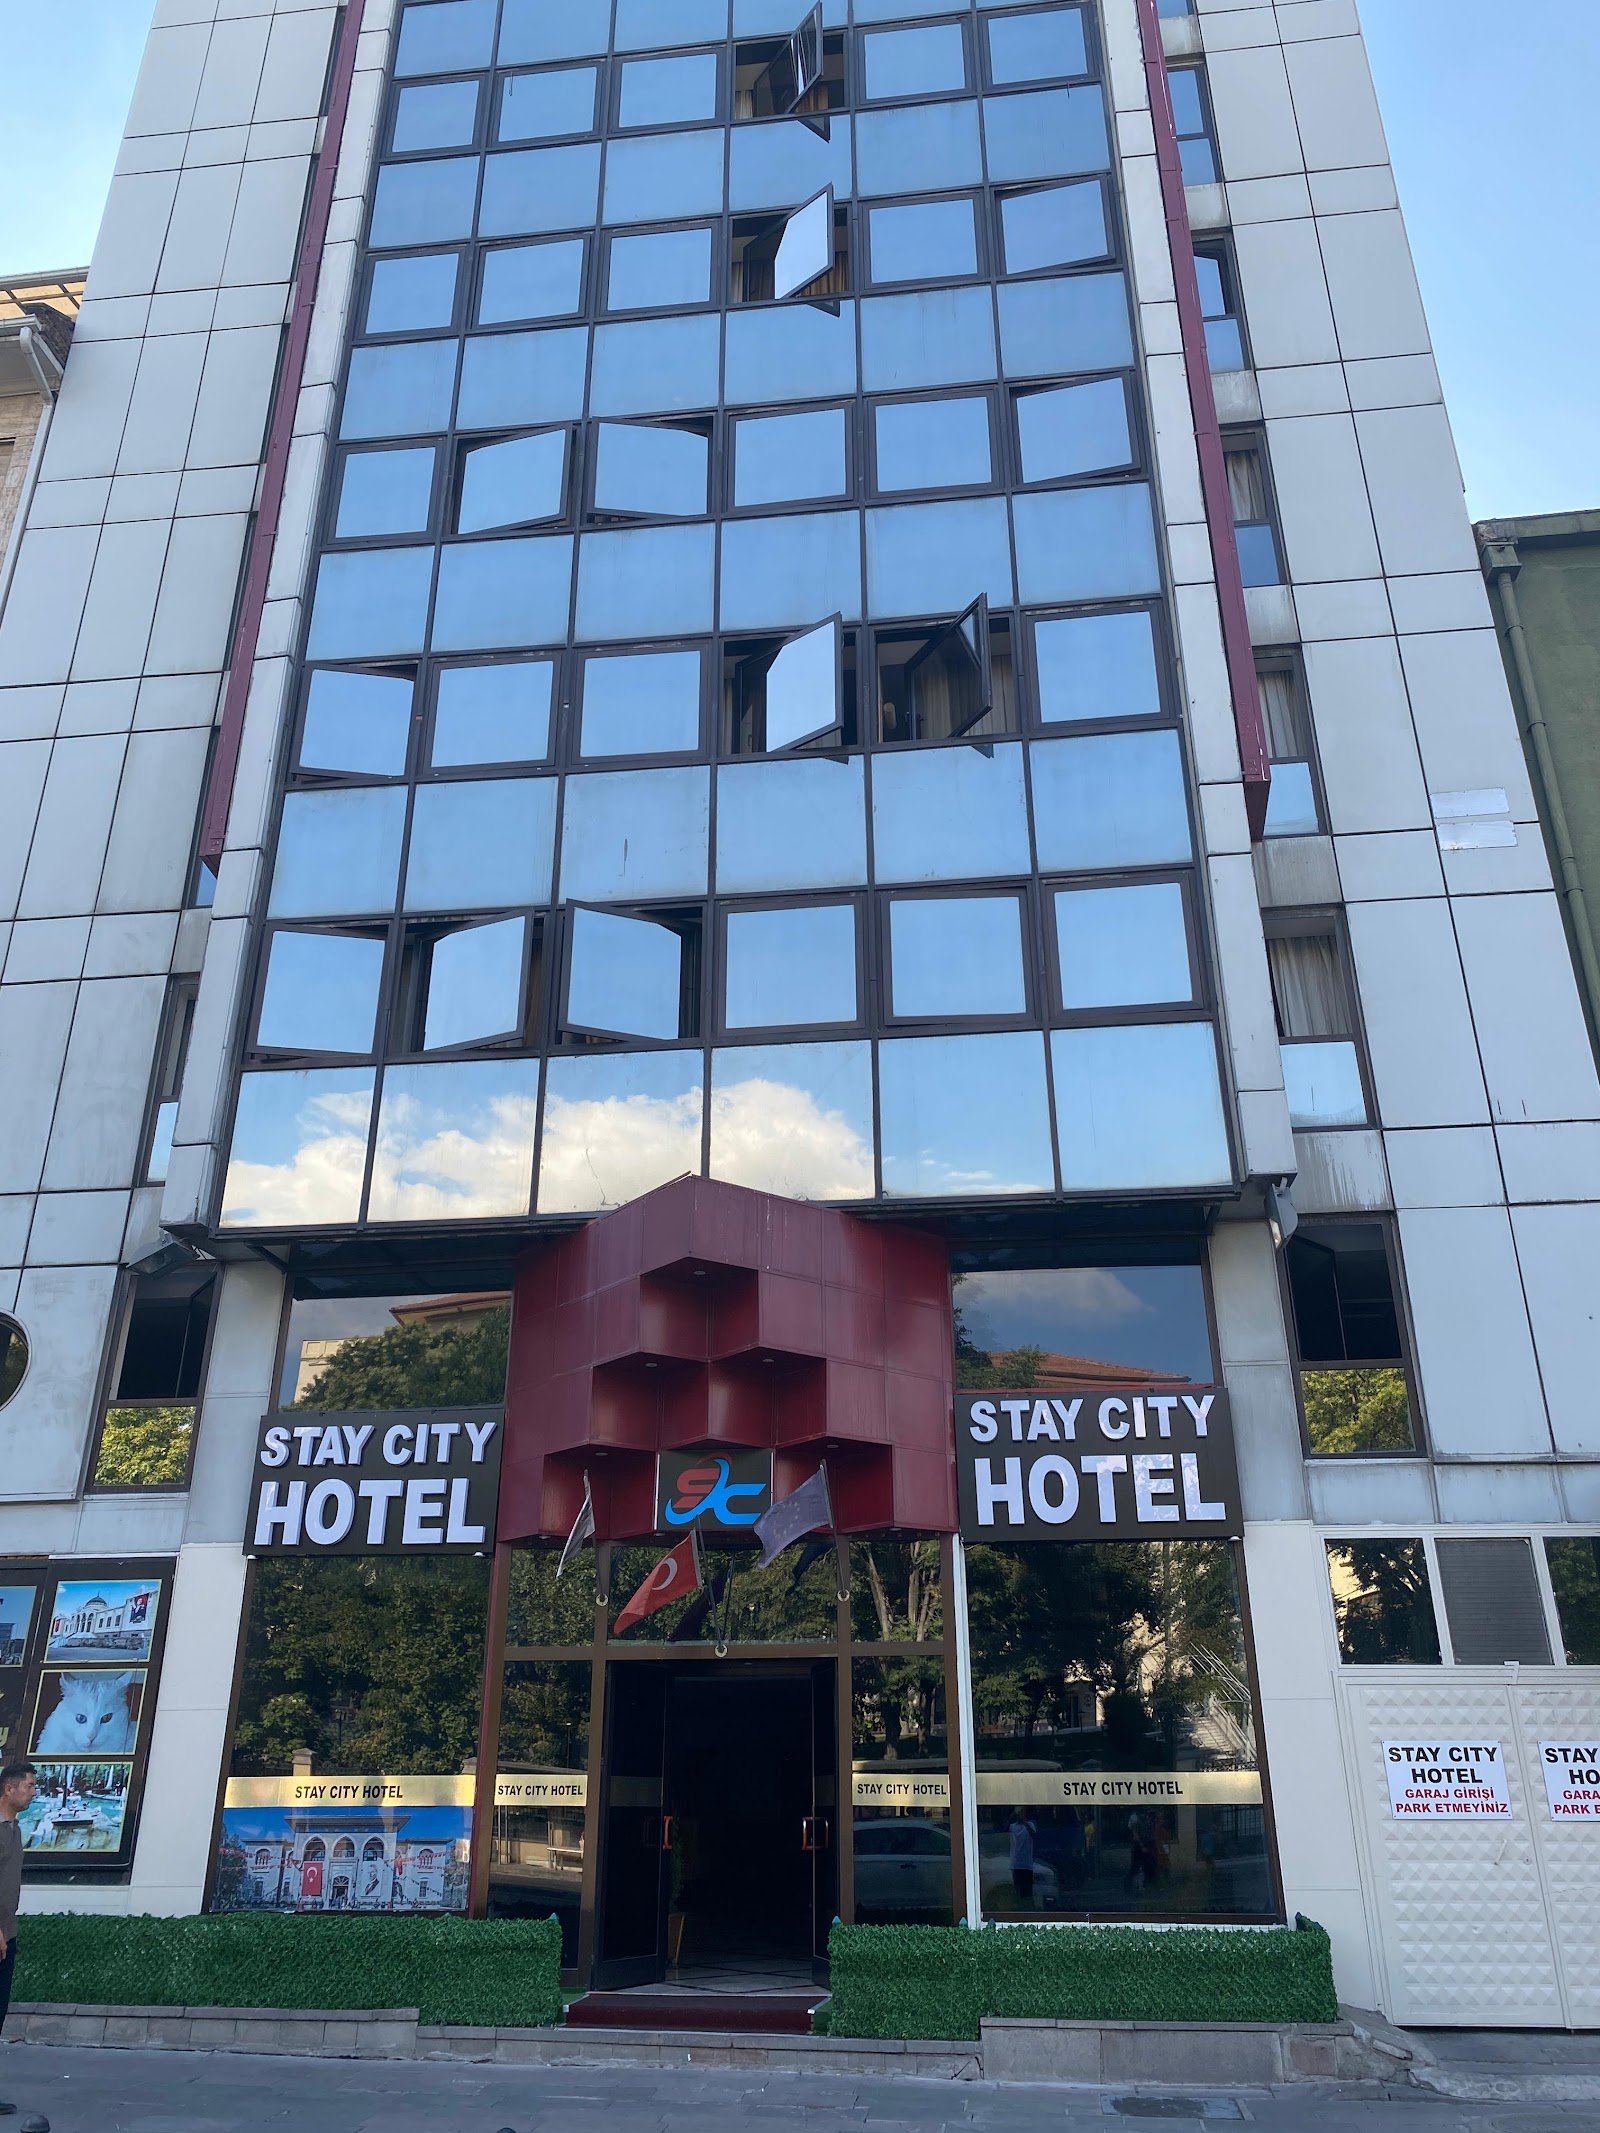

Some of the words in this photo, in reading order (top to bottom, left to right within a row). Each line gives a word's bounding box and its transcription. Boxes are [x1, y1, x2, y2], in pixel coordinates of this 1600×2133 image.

[969, 1398, 1084, 1442] STAY
[1098, 1394, 1216, 1441] CITY
[260, 1424, 376, 1467] STAY
[382, 1421, 497, 1465] CITY
[974, 1453, 1227, 1526] HOTEL
[253, 1477, 486, 1546] HOTEL
[1388, 1746, 1441, 1763] STAY
[1448, 1746, 1498, 1763] CITY
[1544, 1747, 1599, 1764] STAY
[1411, 1768, 1483, 1784] HOTEL
[295, 1785, 327, 1799] STAY
[329, 1785, 360, 1799] CITY
[362, 1785, 404, 1799] HOTEL
[497, 1785, 523, 1796] STAY
[525, 1785, 549, 1796] CITY
[550, 1785, 583, 1796] HOTEL
[857, 1783, 883, 1795] STAY
[885, 1783, 910, 1795] CITY
[912, 1783, 947, 1796] HOTEL
[1063, 1781, 1097, 1796] STAY
[1101, 1781, 1133, 1796] CITY
[1137, 1780, 1184, 1795] HOTEL
[1405, 1788, 1450, 1799] GARAJ
[1453, 1786, 1495, 1801] GİRİŞİ
[1395, 1803, 1432, 1813] PARK
[1435, 1800, 1509, 1813] ETMEYİNİZ
[1553, 1804, 1591, 1815] PARK
